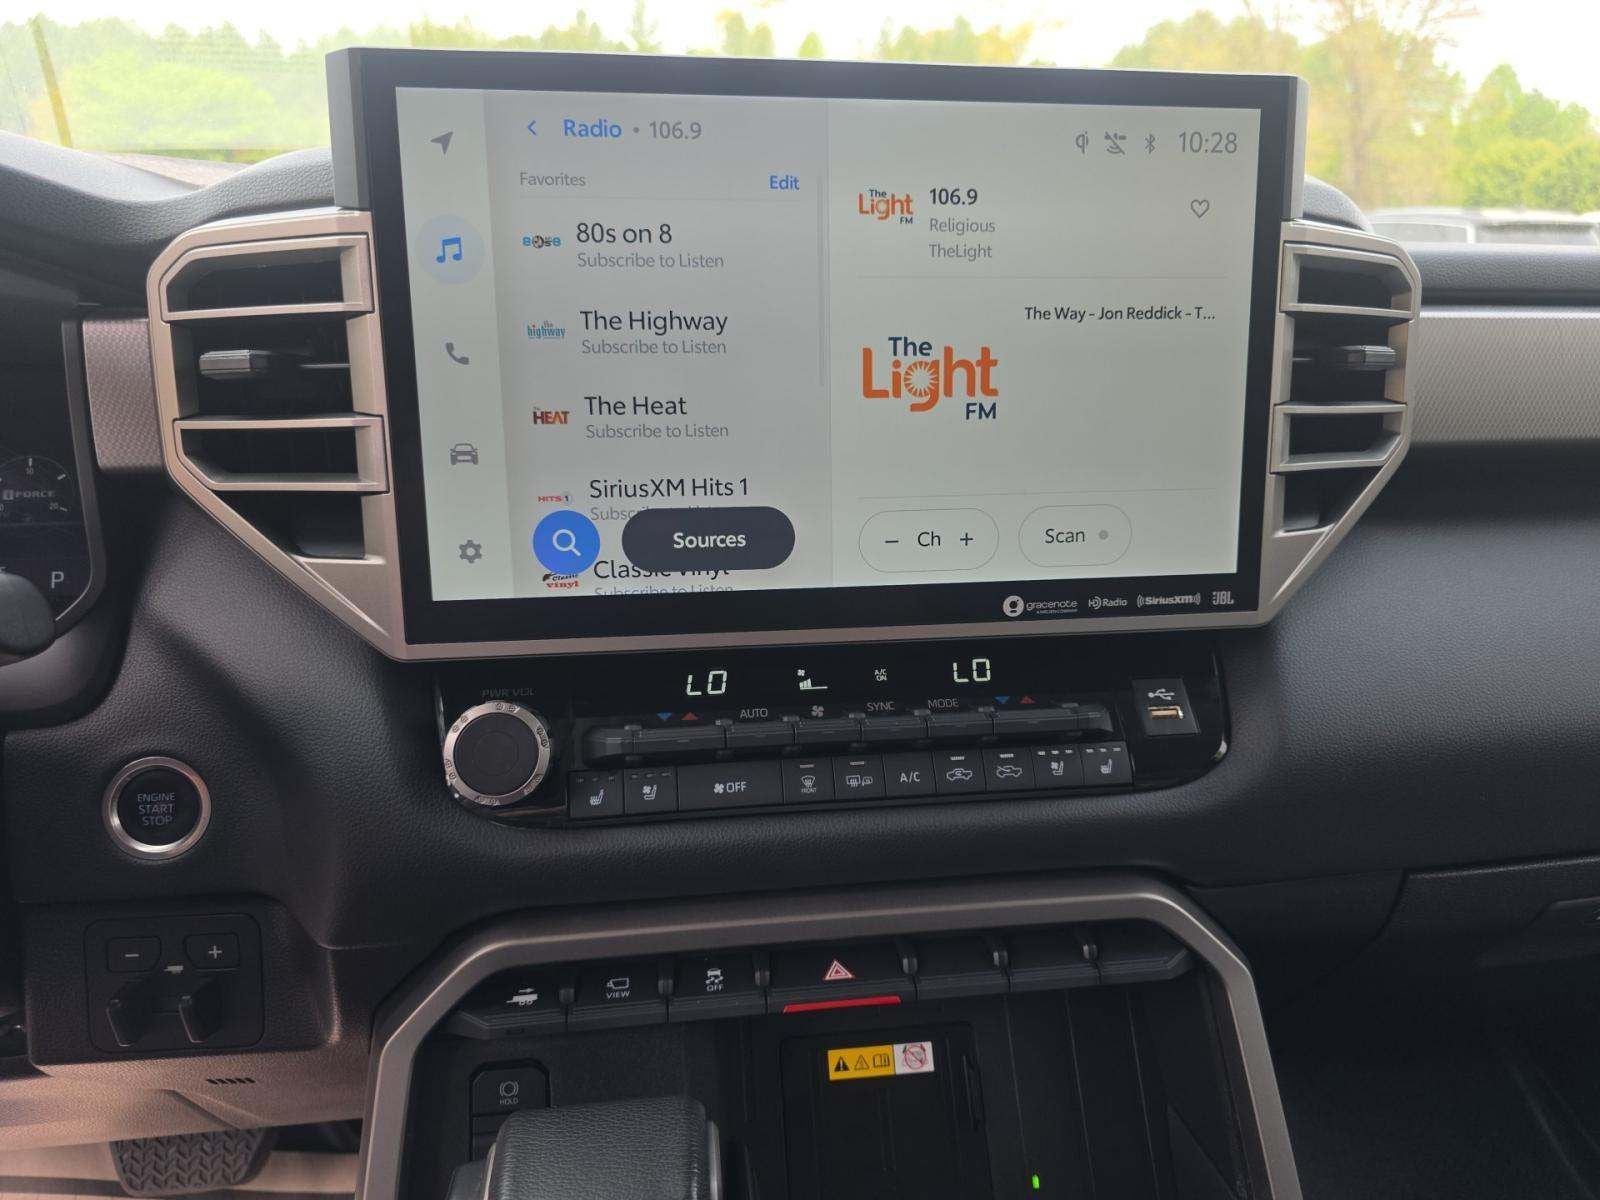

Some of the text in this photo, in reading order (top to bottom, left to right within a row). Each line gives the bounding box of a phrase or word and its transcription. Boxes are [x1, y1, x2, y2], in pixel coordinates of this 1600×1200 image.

[563, 119, 702, 140] Radio 106.9
[1178, 131, 1238, 154] 10:28
[520, 171, 586, 187] Favorites
[769, 174, 800, 191] Edit
[869, 189, 887, 198] The
[929, 188, 978, 205] 106.9
[858, 193, 914, 221] Light
[900, 216, 913, 224] FM
[930, 218, 996, 235] Religious
[576, 223, 673, 244] 80s on 8
[929, 243, 993, 261] TheLight
[577, 253, 724, 269] Subscribe to Listen
[580, 310, 728, 335] The Highway
[1024, 307, 1051, 320] The
[1055, 307, 1086, 323] Way
[1098, 307, 1123, 321] Jon
[1127, 306, 1182, 320] Reddick
[1194, 307, 1216, 320] T...
[527, 324, 566, 339] highway
[582, 339, 726, 355] Subscribe to Listen
[888, 336, 933, 357] The
[862, 346, 1000, 412] Light
[584, 396, 687, 416] The Heat
[965, 402, 997, 420] FM
[532, 411, 570, 424] HEAT
[586, 424, 729, 439] Subscribe to Listen
[590, 478, 749, 498] SiriusXM Hits 1
[673, 532, 747, 548] Sources
[917, 531, 942, 547] Ch
[1044, 527, 1086, 544] Scan
[51, 571, 64, 588] P
[1026, 600, 1078, 611] gracenote
[1102, 598, 1128, 607] Radio
[1213, 591, 1235, 605] JBL
[953, 658, 991, 683] LO
[685, 670, 728, 696] LO
[866, 701, 896, 712] SYNC
[927, 698, 959, 709] MODE
[739, 708, 769, 719] AUTO
[899, 771, 921, 784] A/C
[725, 781, 747, 793] OFF
[137, 793, 175, 802] ENGINE
[138, 804, 174, 815] START
[142, 816, 173, 826] STOP
[606, 989, 631, 999] VIEW
[706, 982, 724, 992] OFF
